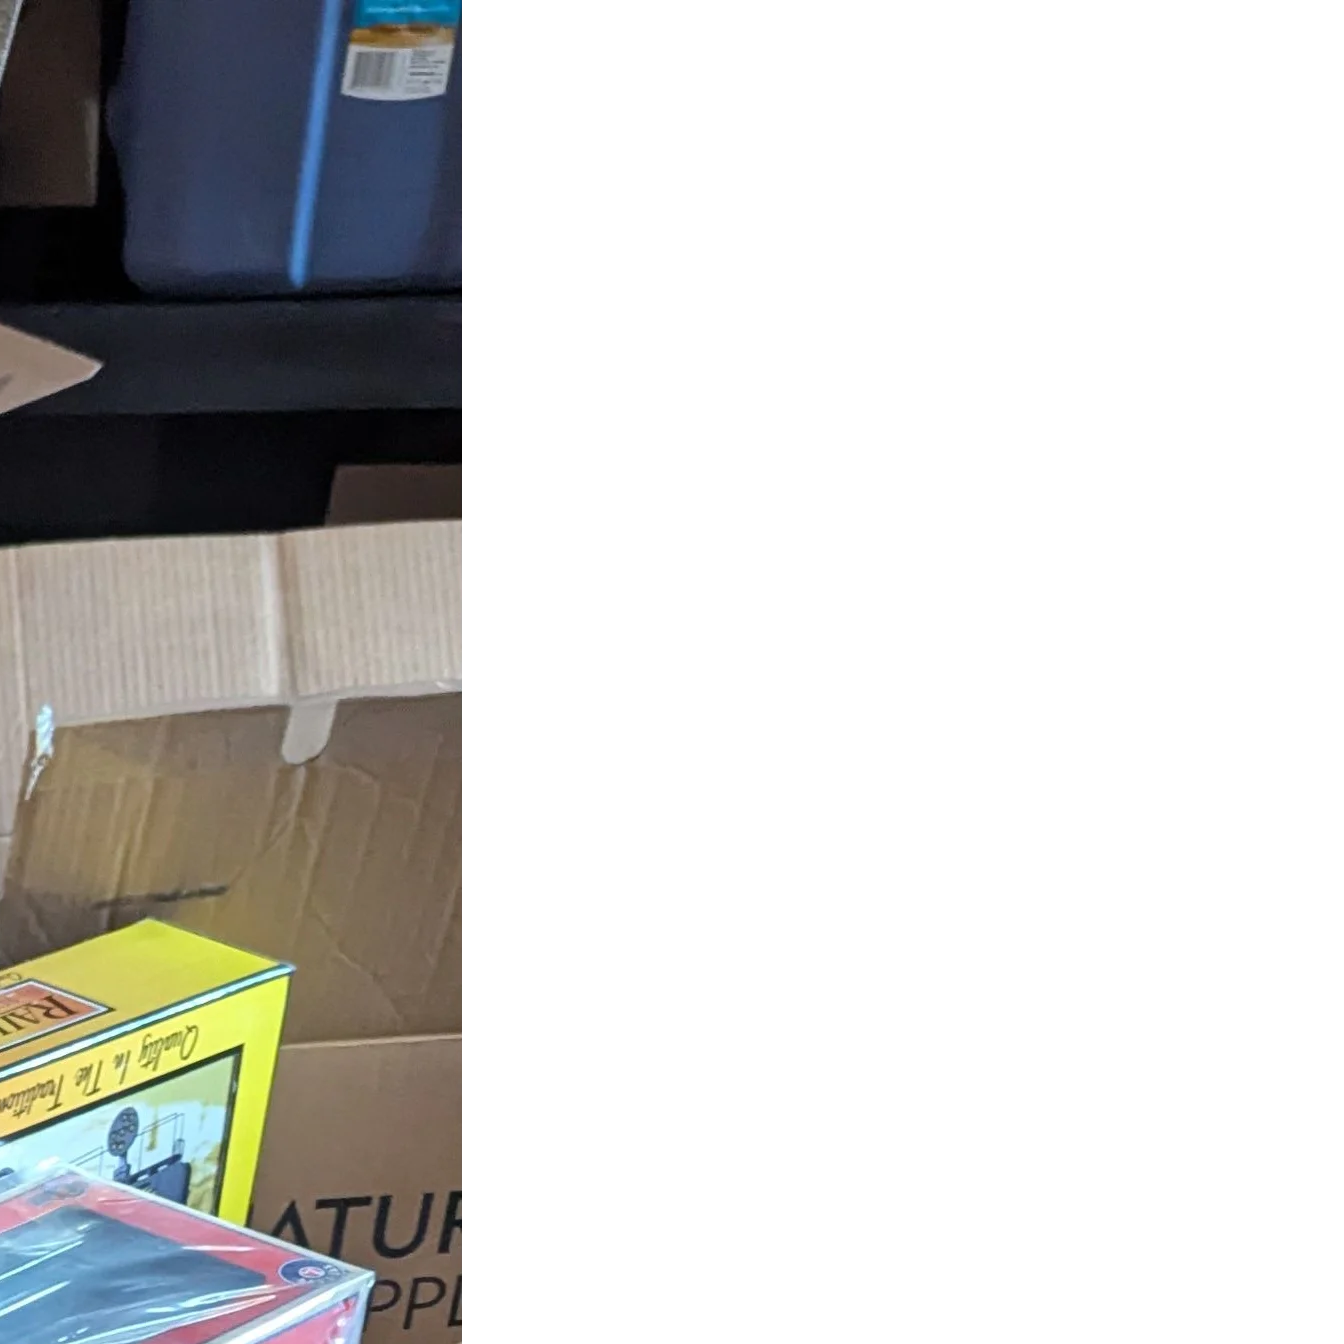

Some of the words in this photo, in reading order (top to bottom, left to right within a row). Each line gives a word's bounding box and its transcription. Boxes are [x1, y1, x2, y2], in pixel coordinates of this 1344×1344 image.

[137, 1025, 199, 1071] Quality
[75, 1061, 103, 1097] The
[113, 1056, 131, 1088] In
